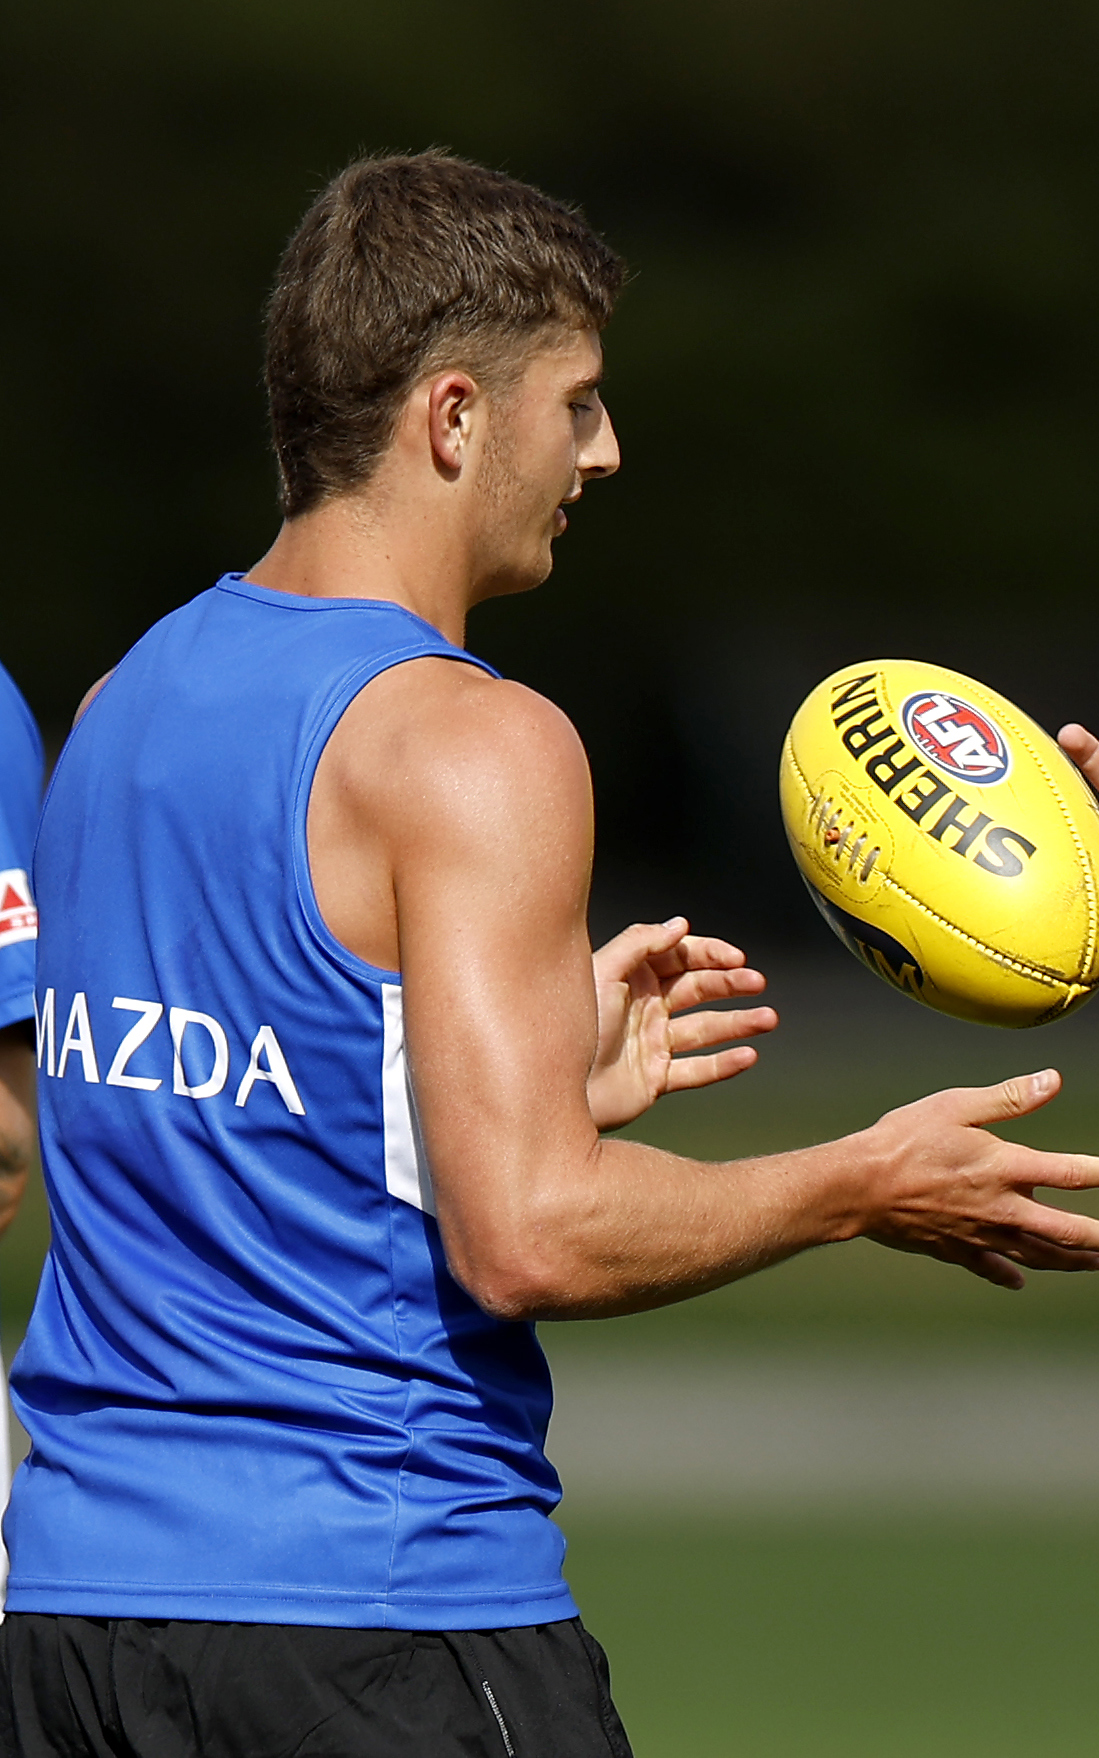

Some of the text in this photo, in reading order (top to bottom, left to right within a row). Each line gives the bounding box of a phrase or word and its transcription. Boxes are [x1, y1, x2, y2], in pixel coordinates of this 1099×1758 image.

[831, 672, 1037, 877] SHERRIN
[911, 695, 1005, 769] AFL
[34, 988, 306, 1116] MAZDA
